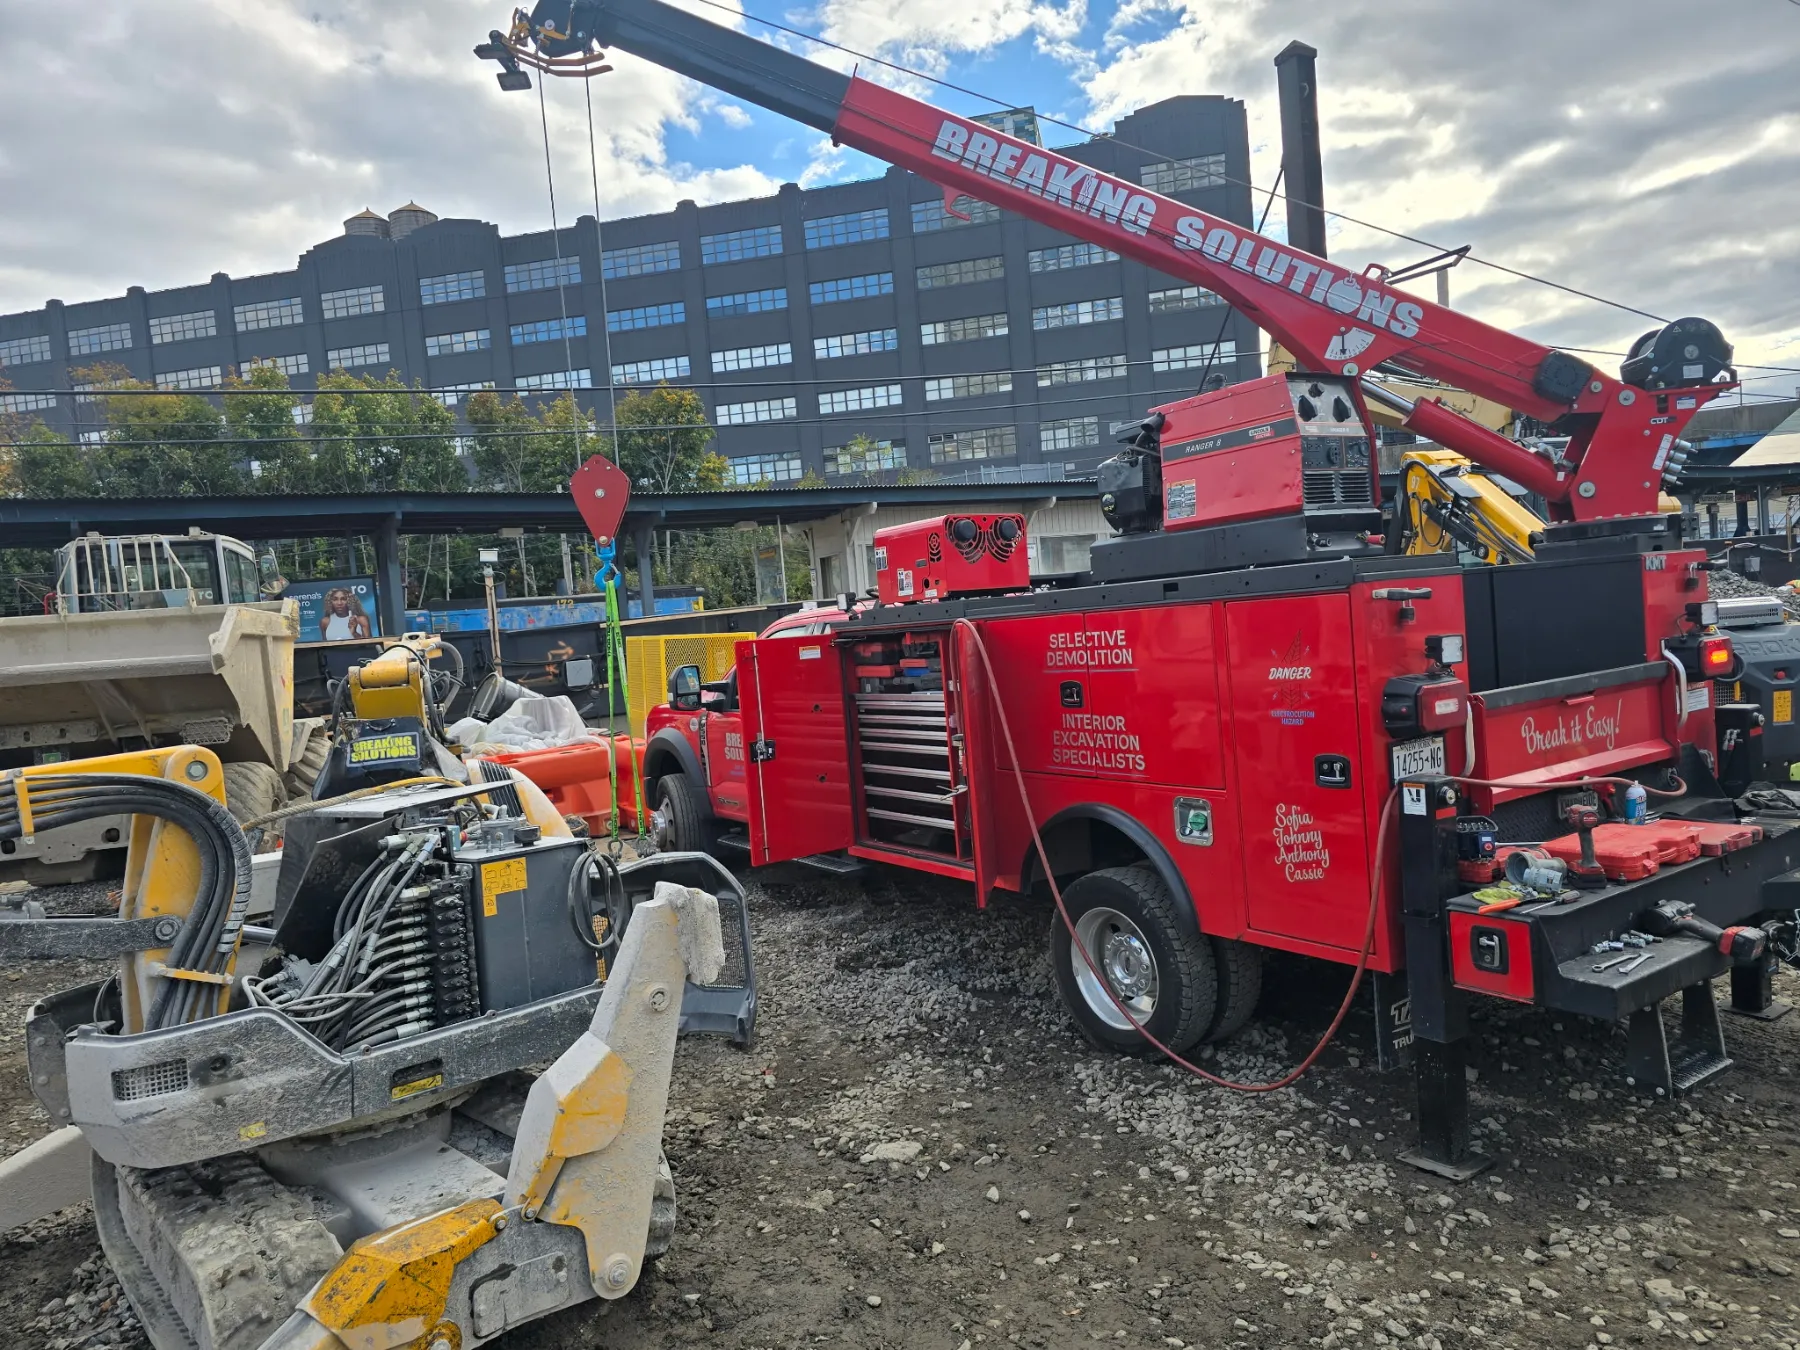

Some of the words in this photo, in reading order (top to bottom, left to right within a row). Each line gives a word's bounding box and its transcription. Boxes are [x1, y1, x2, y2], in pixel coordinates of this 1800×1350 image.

[931, 119, 1157, 237] BREAKING
[1173, 215, 1424, 338] SOLUTIONS
[1185, 441, 1214, 453] RANGER
[1645, 555, 1667, 571] KMT
[351, 585, 367, 595] ro
[1049, 629, 1127, 649] SELECTIVE
[1046, 648, 1133, 667] DEMOLITION
[1268, 666, 1312, 680] DANGER
[1062, 713, 1126, 732] INTERIOR
[1521, 716, 1569, 754] Break
[1571, 714, 1582, 744] it
[1586, 698, 1622, 751] Easy!
[352, 736, 413, 752] BREAKING
[726, 732, 744, 748] BRE
[1053, 730, 1140, 751] EXCAVATION
[351, 745, 417, 762] SOLUTIONS
[1052, 748, 1146, 771] SPECIALISTS
[1275, 803, 1314, 832] Sofia
[1273, 826, 1323, 850] Johnny
[1275, 844, 1330, 868] Anthony
[1285, 863, 1325, 883] Cassie
[1392, 1031, 1414, 1050] TRU
